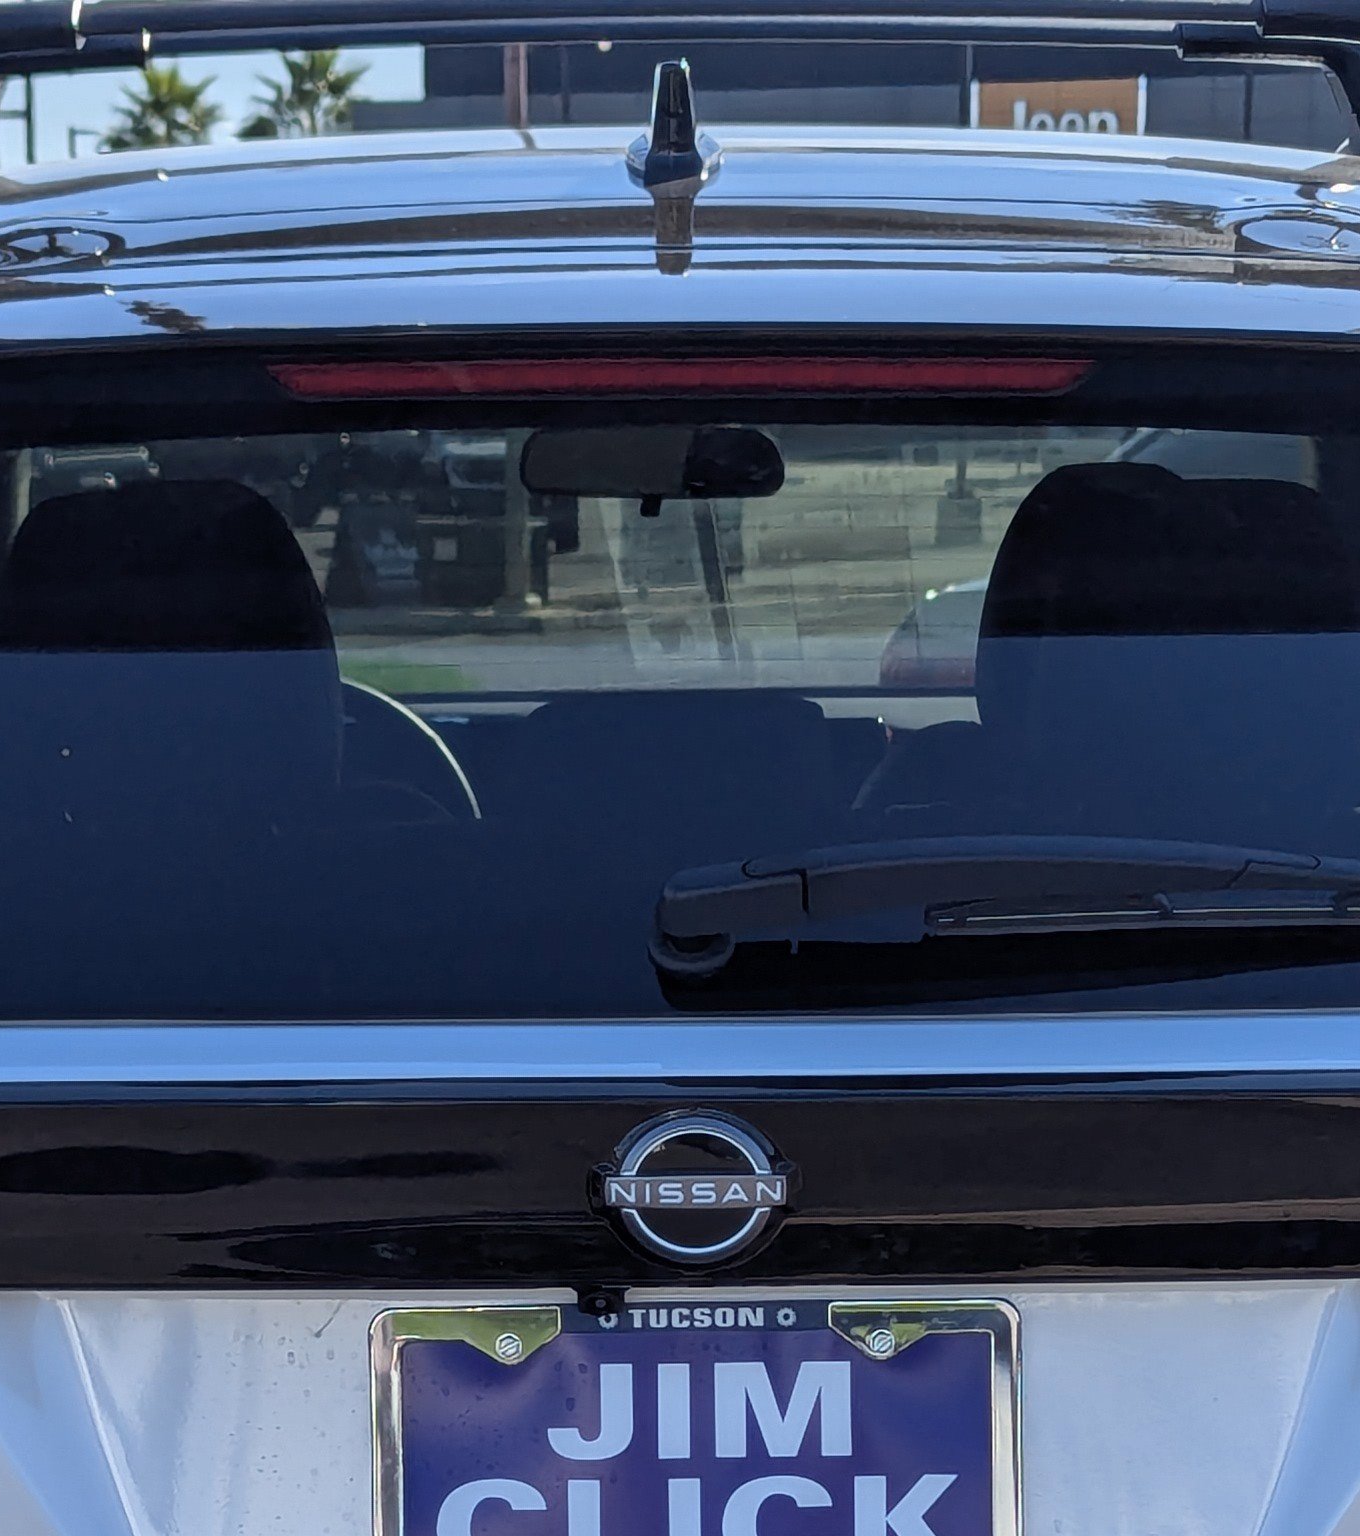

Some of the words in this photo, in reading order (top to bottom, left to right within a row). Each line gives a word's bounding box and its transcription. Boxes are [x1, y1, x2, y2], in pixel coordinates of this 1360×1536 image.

[610, 1181, 782, 1204] NISSAN
[628, 1307, 764, 1328] TUCSON
[547, 1361, 852, 1459] JIM
